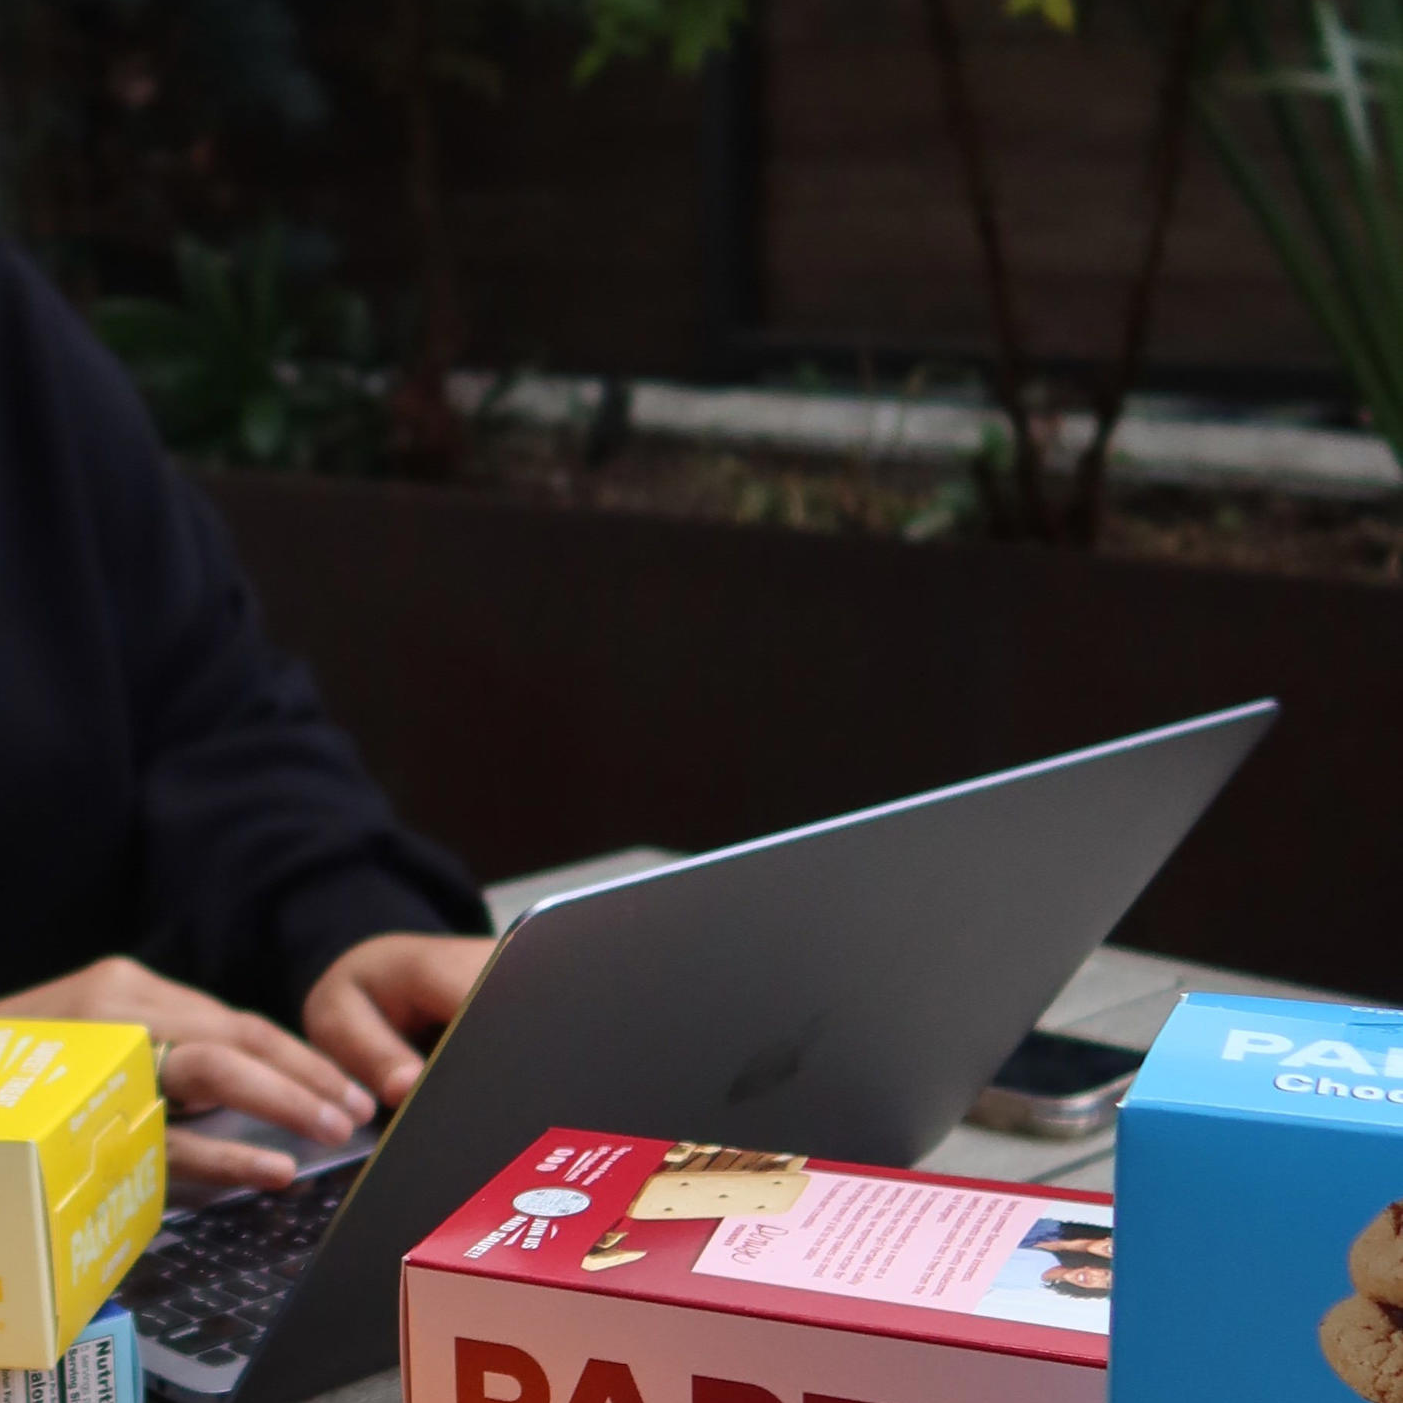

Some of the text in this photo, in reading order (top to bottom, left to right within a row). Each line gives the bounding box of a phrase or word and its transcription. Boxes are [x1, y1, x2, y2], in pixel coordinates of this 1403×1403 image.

[1221, 1028, 1403, 1078] PA
[463, 1214, 529, 1259] AND SAVE!!
[521, 1218, 550, 1250] JOIN US
[68, 1348, 78, 1389] Serving
